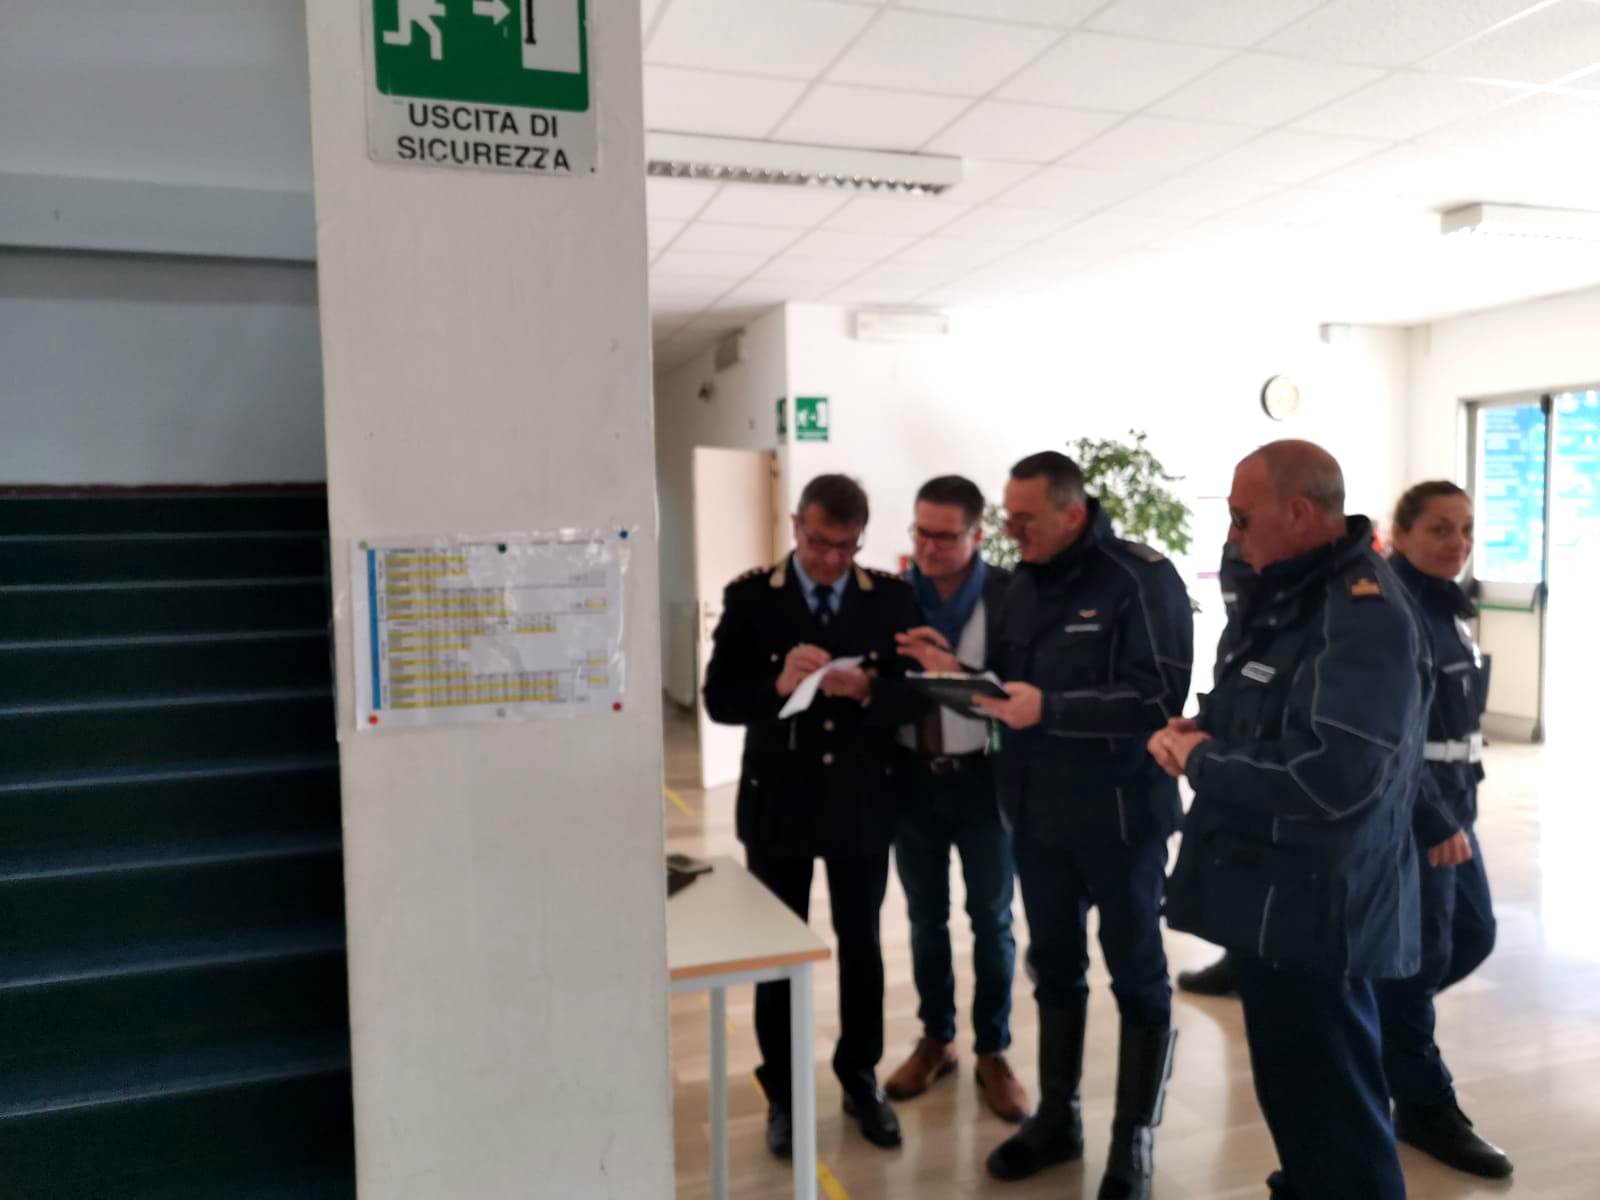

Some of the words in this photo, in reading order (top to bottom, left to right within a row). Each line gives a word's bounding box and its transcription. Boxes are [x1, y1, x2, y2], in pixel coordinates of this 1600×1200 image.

[408, 102, 519, 135] USCITA
[530, 114, 558, 138] DI
[397, 135, 571, 171] SICUREZZA
